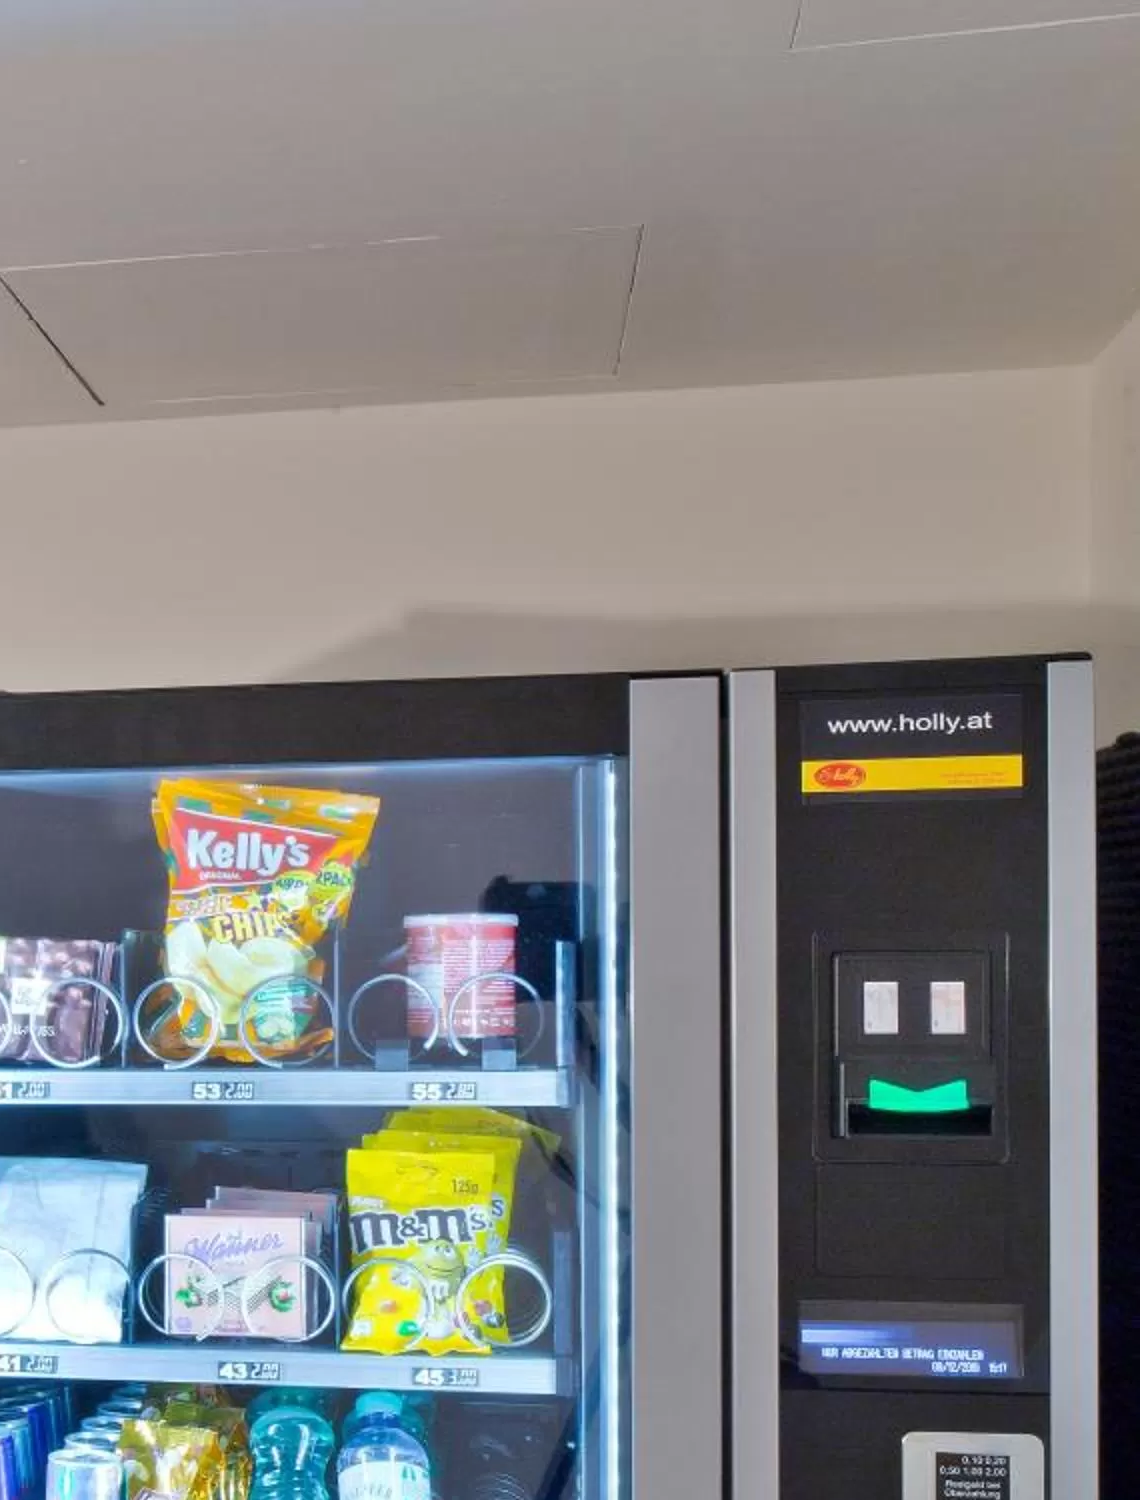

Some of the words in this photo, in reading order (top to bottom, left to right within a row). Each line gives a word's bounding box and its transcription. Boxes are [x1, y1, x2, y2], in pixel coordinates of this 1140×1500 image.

[827, 711, 993, 734] www.holly.at
[186, 828, 310, 876] Kelly's
[193, 1083, 221, 1099] 53
[224, 1083, 253, 1099] 2.00
[412, 1083, 442, 1100] 55
[452, 1178, 479, 1195] 125g
[219, 1362, 248, 1379] 43
[415, 1369, 445, 1385] 45
